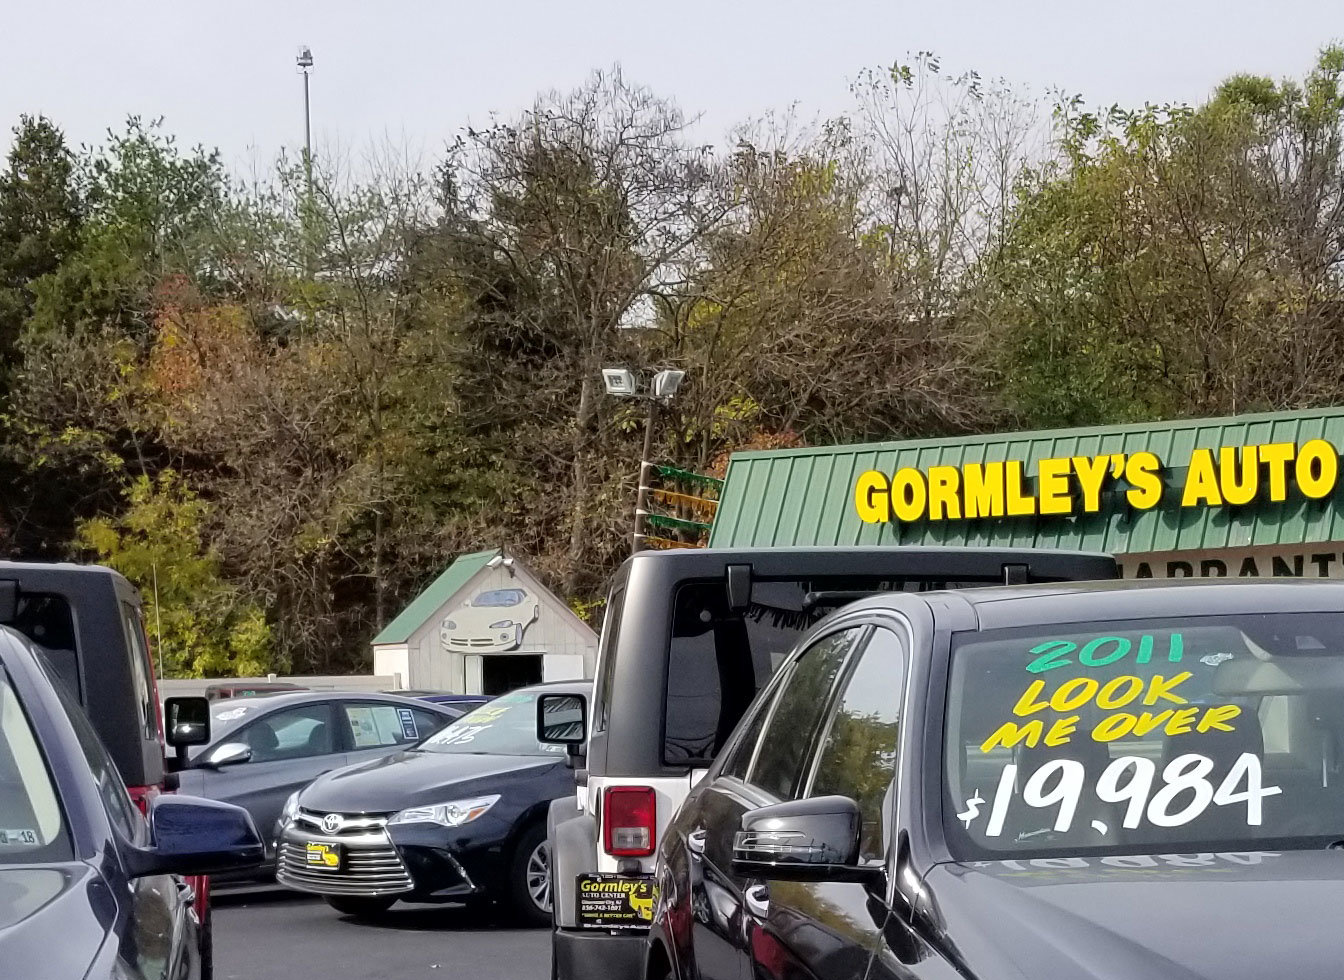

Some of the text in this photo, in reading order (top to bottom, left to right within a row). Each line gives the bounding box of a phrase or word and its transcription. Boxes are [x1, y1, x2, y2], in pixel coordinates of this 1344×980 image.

[855, 438, 1339, 524] GORMLEY'S AUTO
[1026, 633, 1183, 674] 2011
[1013, 671, 1194, 717] LOOK
[980, 704, 1242, 753] ME OVER
[956, 752, 1282, 836] $19,984
[581, 880, 647, 895] Gormley's
